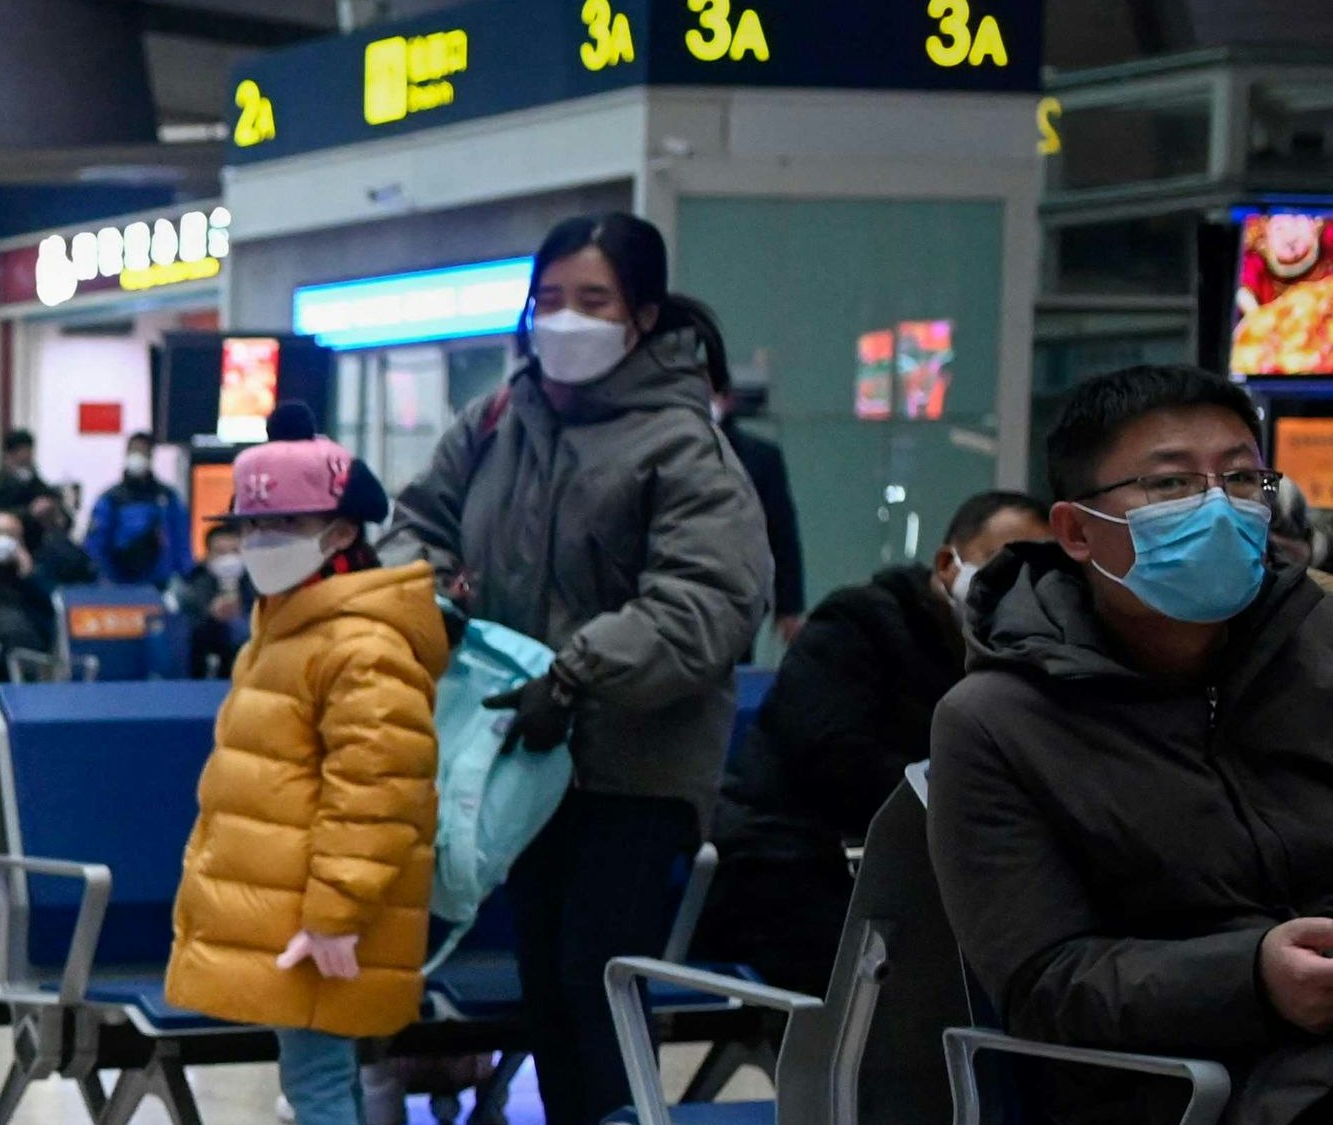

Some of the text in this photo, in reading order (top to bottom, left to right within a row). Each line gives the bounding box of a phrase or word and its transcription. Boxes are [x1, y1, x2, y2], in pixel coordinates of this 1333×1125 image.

[580, 0, 635, 71] 3A
[685, 0, 770, 62] 3A
[925, 0, 1009, 67] 3A
[233, 79, 276, 148] 2A
